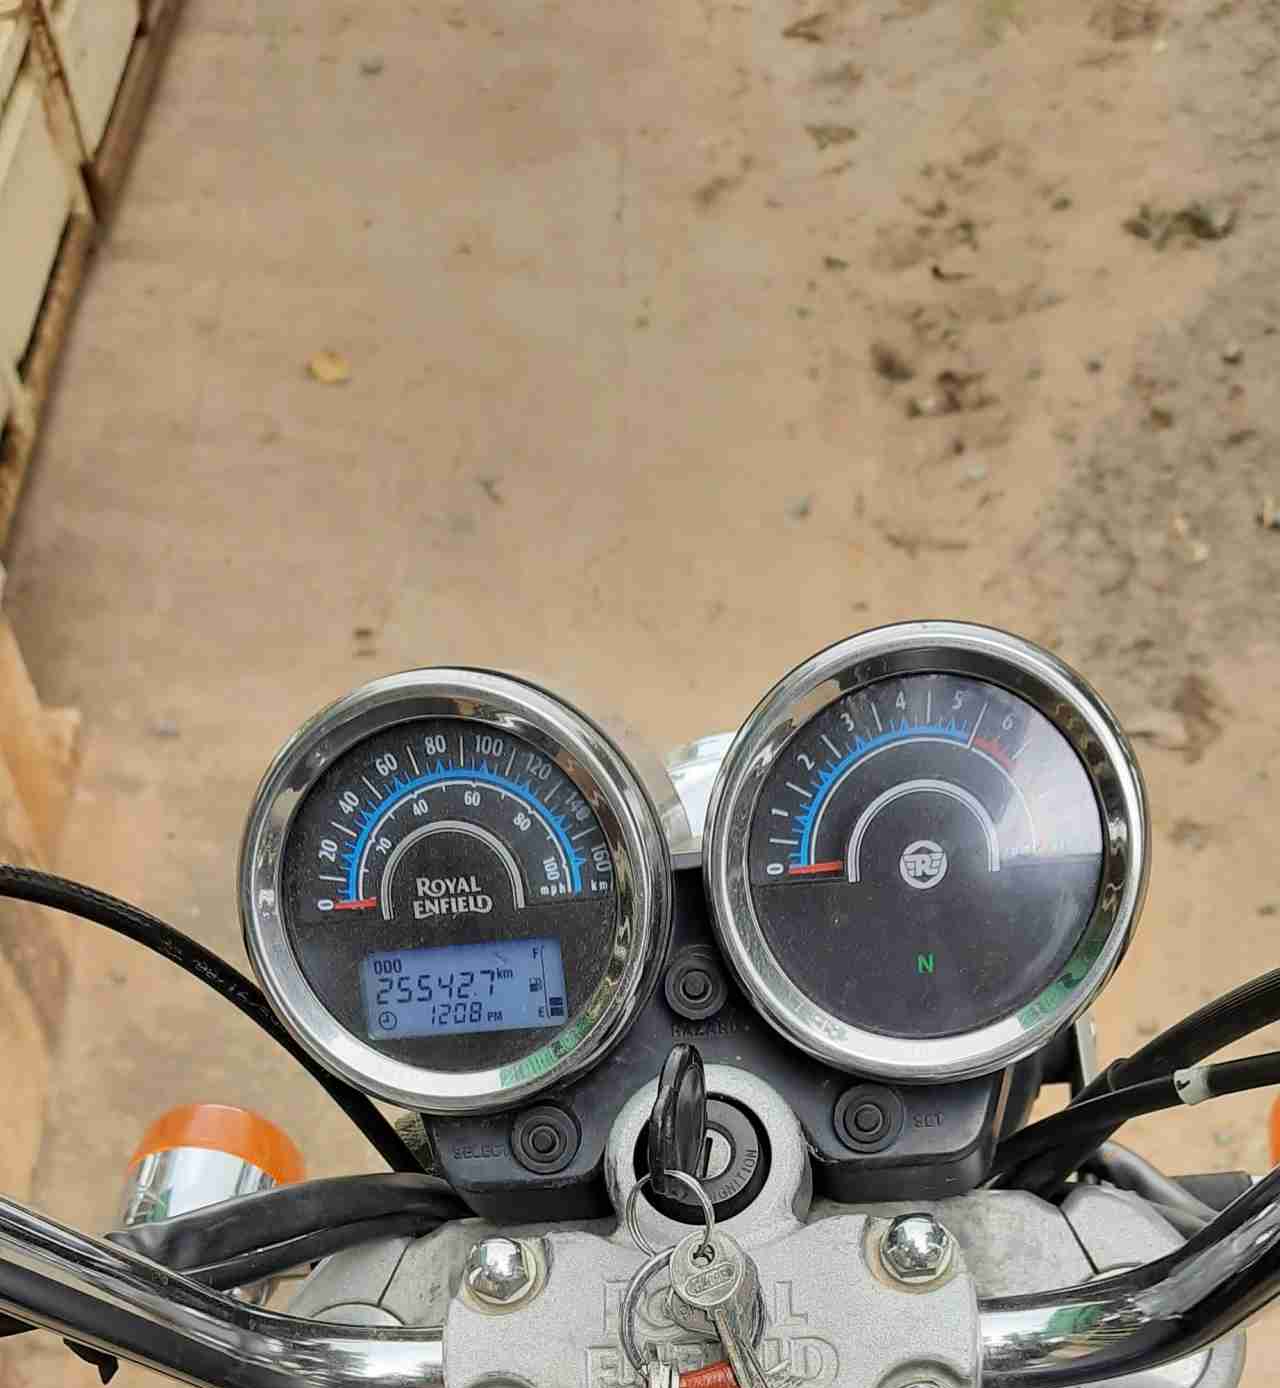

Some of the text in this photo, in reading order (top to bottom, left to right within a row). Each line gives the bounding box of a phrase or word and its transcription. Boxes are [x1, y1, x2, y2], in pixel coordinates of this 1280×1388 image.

[766, 691, 1016, 875] 0 1 2 3 4 5 6
[317, 735, 613, 912] 0 20 40 60 80 100 120 140 160
[412, 798, 429, 818] 40
[464, 790, 481, 807] 60
[513, 812, 532, 832] 80
[542, 856, 561, 881] 100
[415, 875, 482, 898] ROYAL
[540, 882, 566, 897] mph
[412, 894, 494, 920] ENFIELD
[532, 946, 540, 960] F
[496, 966, 514, 981] km
[917, 954, 934, 974] N
[487, 1010, 504, 1023] PM
[538, 1006, 546, 1019] E
